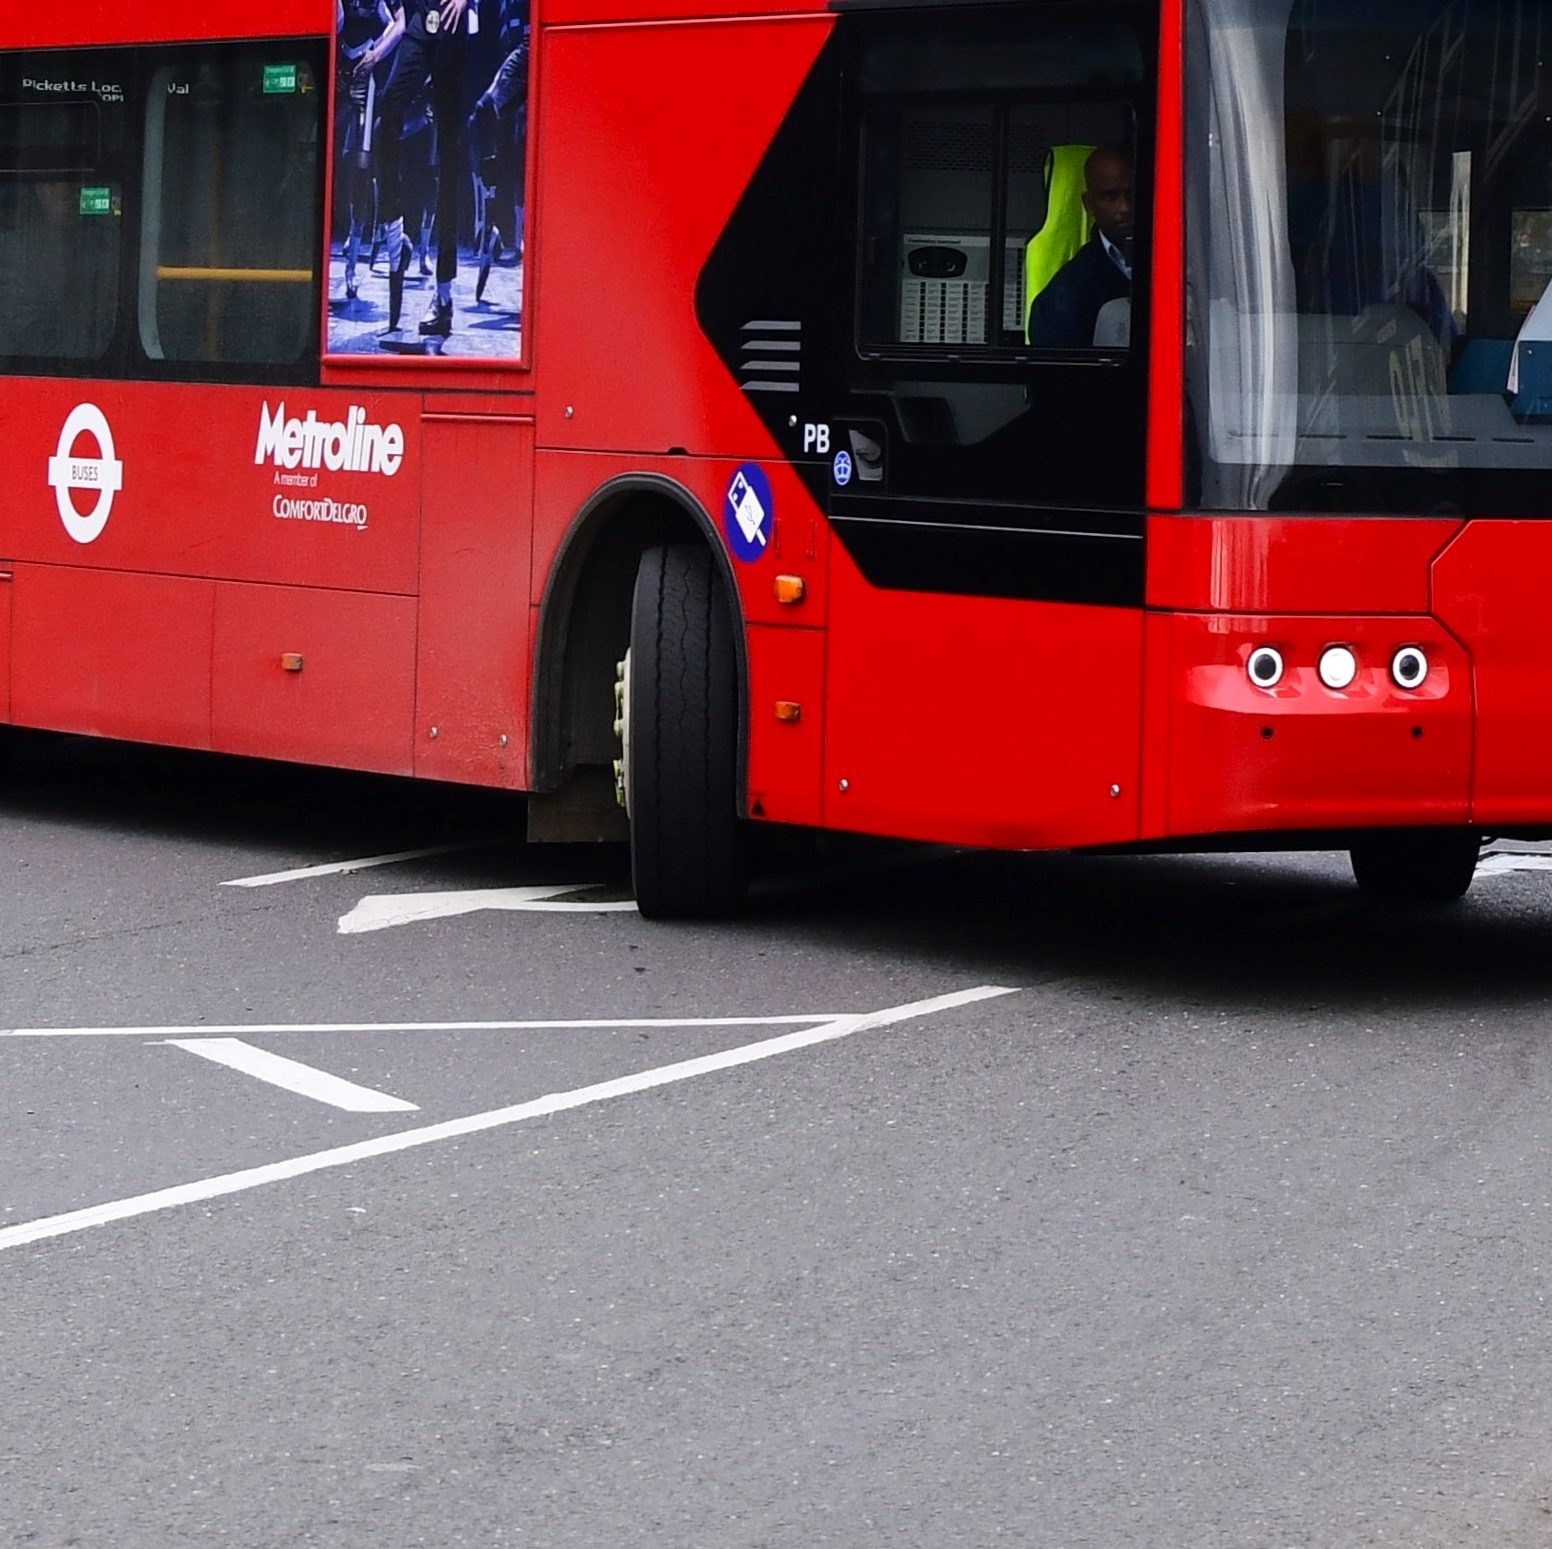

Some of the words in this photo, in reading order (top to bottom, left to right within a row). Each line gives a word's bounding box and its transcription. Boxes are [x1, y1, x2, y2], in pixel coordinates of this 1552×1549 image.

[254, 400, 404, 476] Metroline
[803, 423, 830, 454] PB
[71, 464, 99, 482] BUSES
[273, 470, 280, 485] A
[281, 473, 309, 487] member
